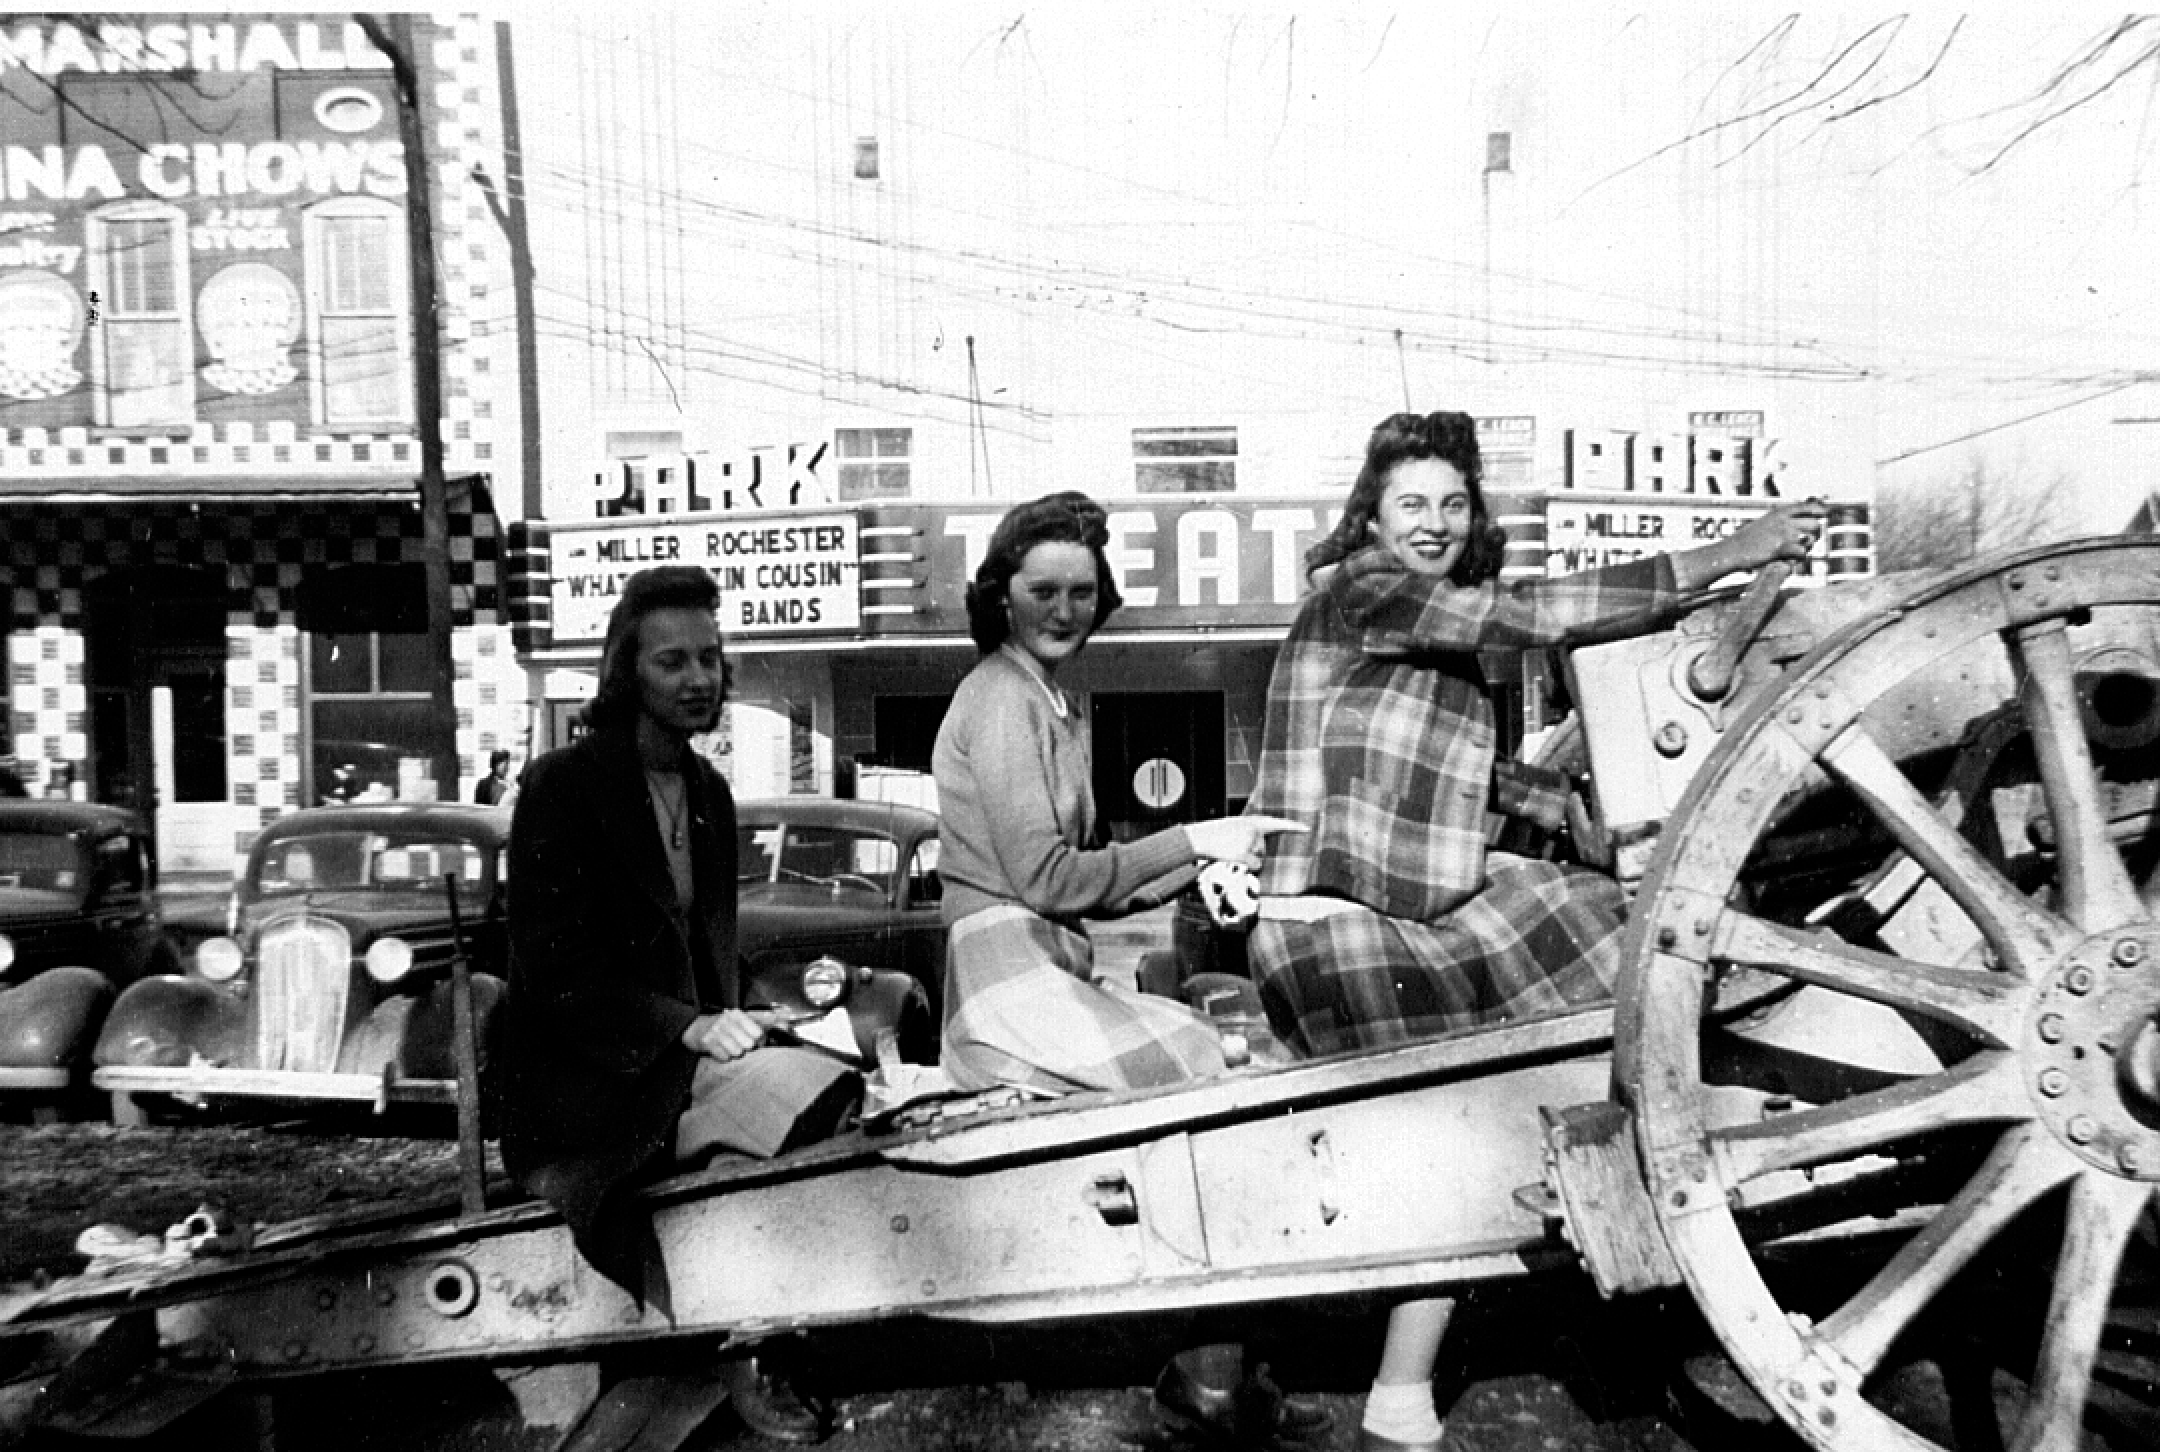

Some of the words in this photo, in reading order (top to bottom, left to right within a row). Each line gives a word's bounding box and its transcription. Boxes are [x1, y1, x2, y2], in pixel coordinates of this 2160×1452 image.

[0, 143, 126, 200] NA
[139, 140, 407, 196] CHOWS
[594, 440, 834, 518] PARK
[1562, 427, 1790, 498] PARK
[596, 535, 680, 563] MILLER
[706, 525, 845, 557] ROCHESTER
[1585, 512, 1664, 539] MILLER
[740, 597, 822, 626] BANDS
